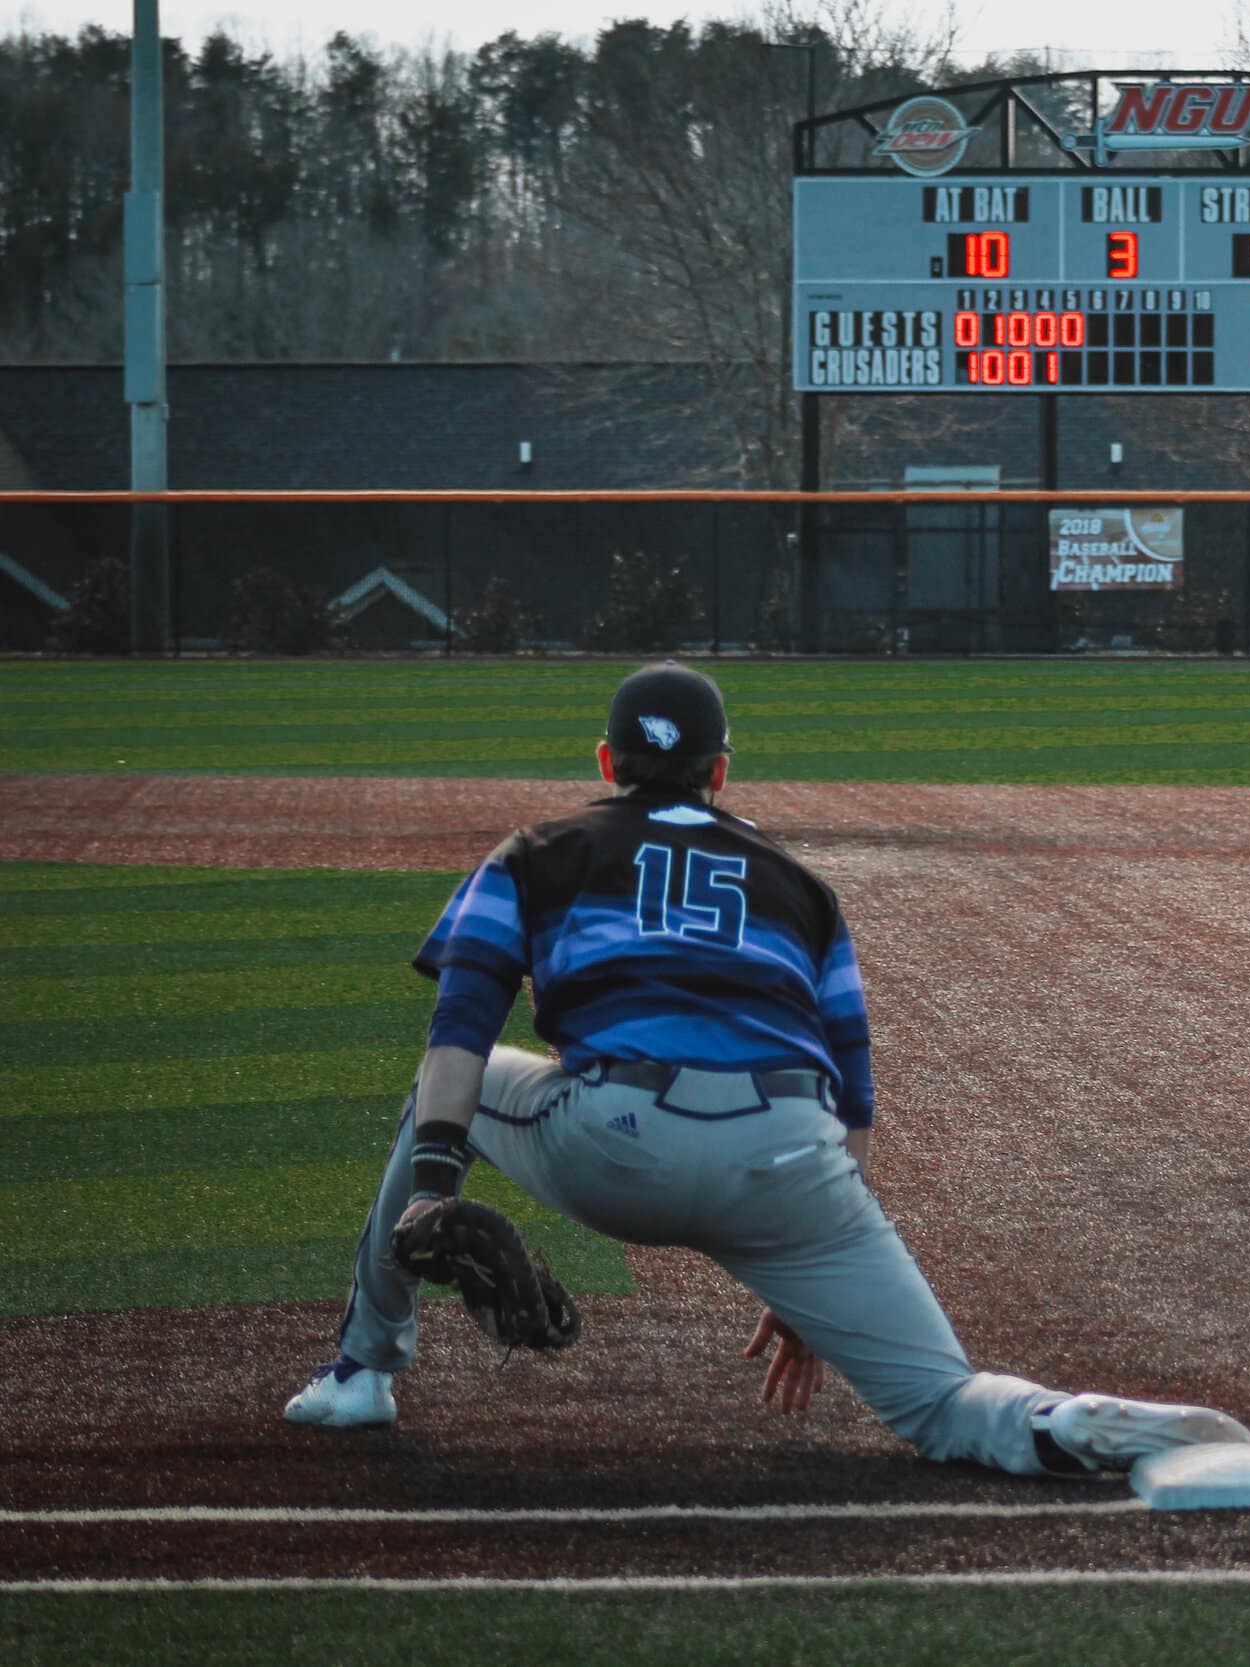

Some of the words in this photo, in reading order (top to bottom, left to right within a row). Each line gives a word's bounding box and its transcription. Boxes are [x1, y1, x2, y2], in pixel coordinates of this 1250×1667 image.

[935, 187, 964, 222] AT
[974, 187, 1017, 222] BAT
[1093, 187, 1151, 222] BALL
[965, 231, 1009, 278] 10
[1109, 231, 1138, 278] 3
[962, 291, 970, 309] 1
[988, 291, 997, 309] 2
[1014, 291, 1023, 309] 3
[1040, 291, 1050, 309] 4
[1067, 291, 1076, 309] 5
[1093, 291, 1102, 309] 6
[1120, 291, 1127, 309] 7
[1147, 291, 1155, 309] 8
[814, 312, 937, 346] GUESTS
[812, 351, 940, 385] CRUSADERS
[1060, 518, 1101, 536] 2018
[1056, 560, 1173, 584] CHAMPION
[633, 842, 746, 950] 15
